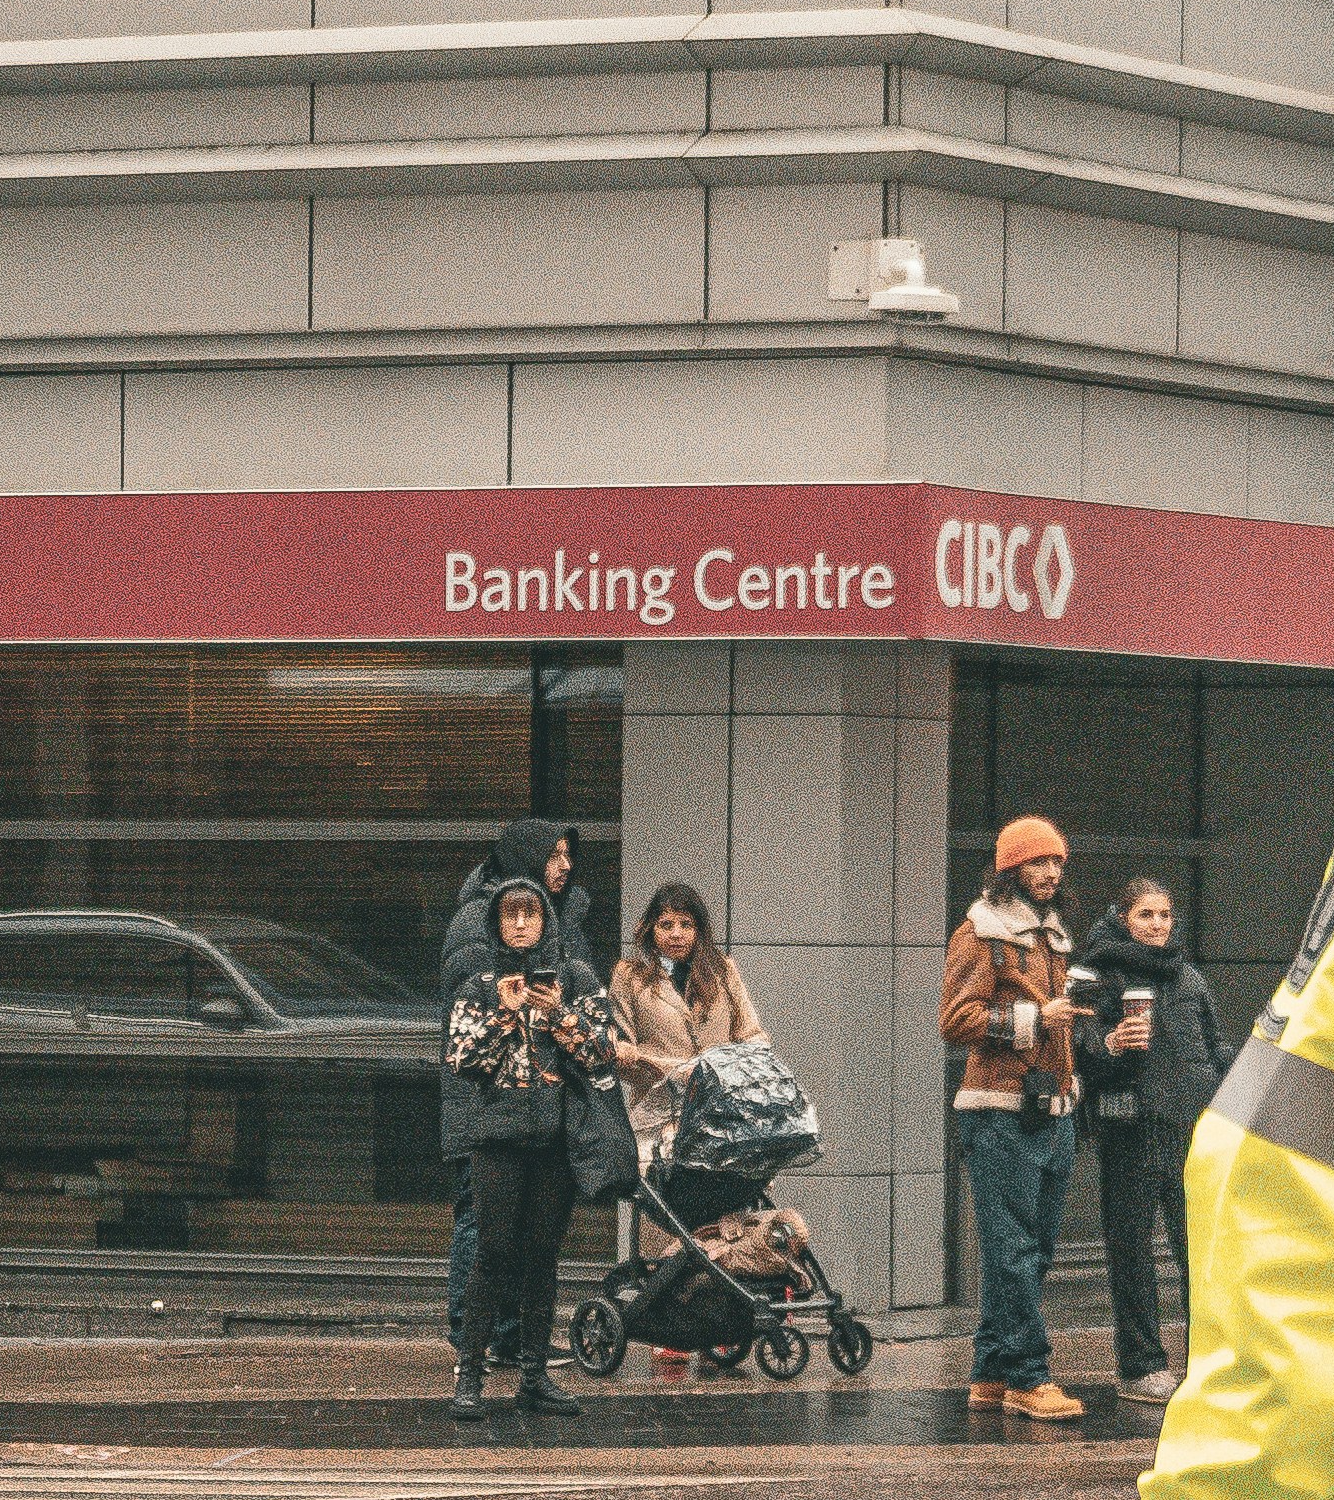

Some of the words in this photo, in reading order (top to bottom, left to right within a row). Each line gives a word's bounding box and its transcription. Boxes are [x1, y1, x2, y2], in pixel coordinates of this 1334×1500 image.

[443, 548, 677, 625] Banking
[693, 547, 896, 611] Centre
[933, 519, 1032, 615] CIBC
